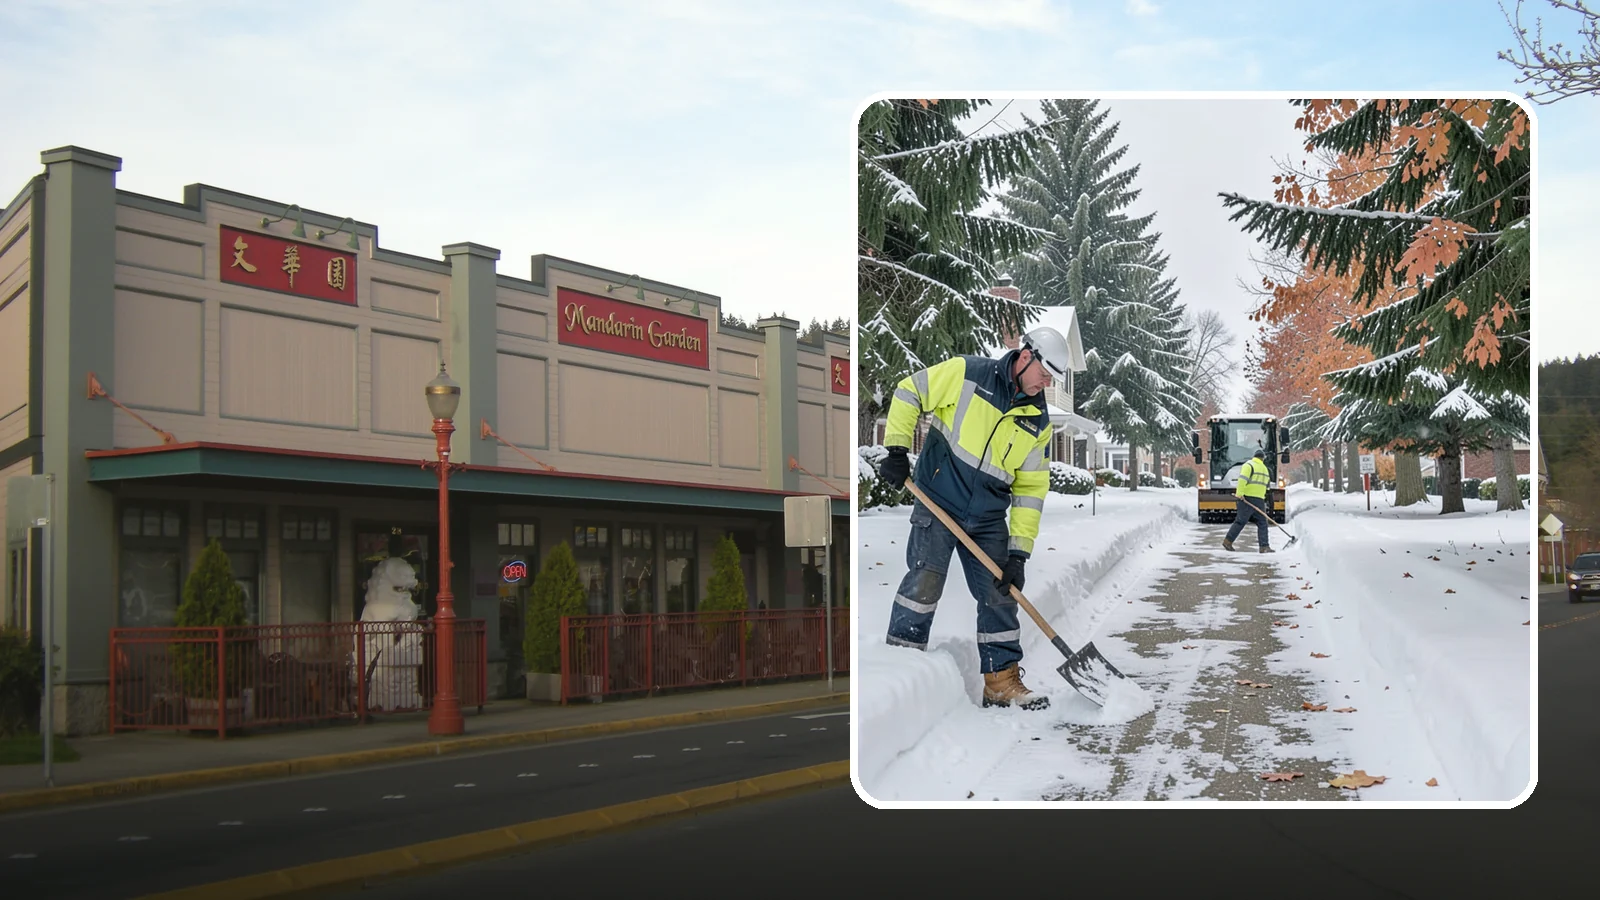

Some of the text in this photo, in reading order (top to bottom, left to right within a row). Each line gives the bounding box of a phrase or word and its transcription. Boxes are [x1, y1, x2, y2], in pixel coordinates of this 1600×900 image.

[230, 236, 346, 291] 文華園
[565, 302, 701, 352] Mandarin Garden
[503, 565, 527, 578] OPEN
